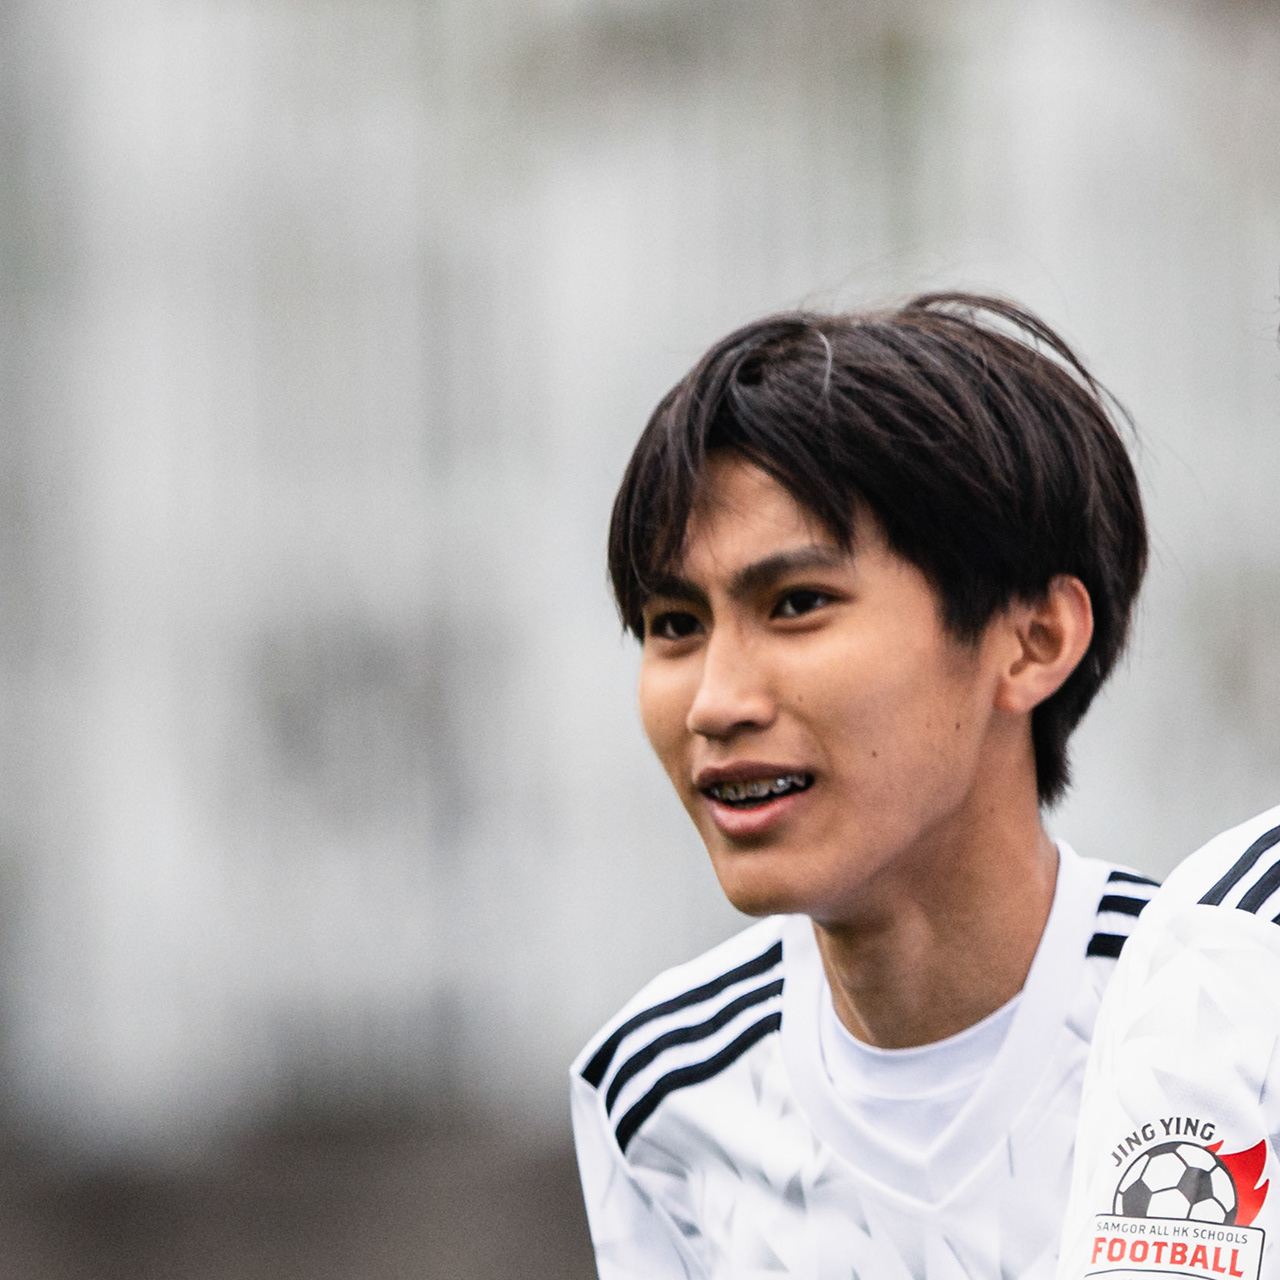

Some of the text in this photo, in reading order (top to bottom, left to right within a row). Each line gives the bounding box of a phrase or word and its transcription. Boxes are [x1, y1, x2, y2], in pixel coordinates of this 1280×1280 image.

[1111, 1117, 1216, 1167] JING YING
[1096, 1221, 1248, 1244] SAMGOR ALL HK SCHOOLS
[1091, 1237, 1244, 1278] FOOTBALL
